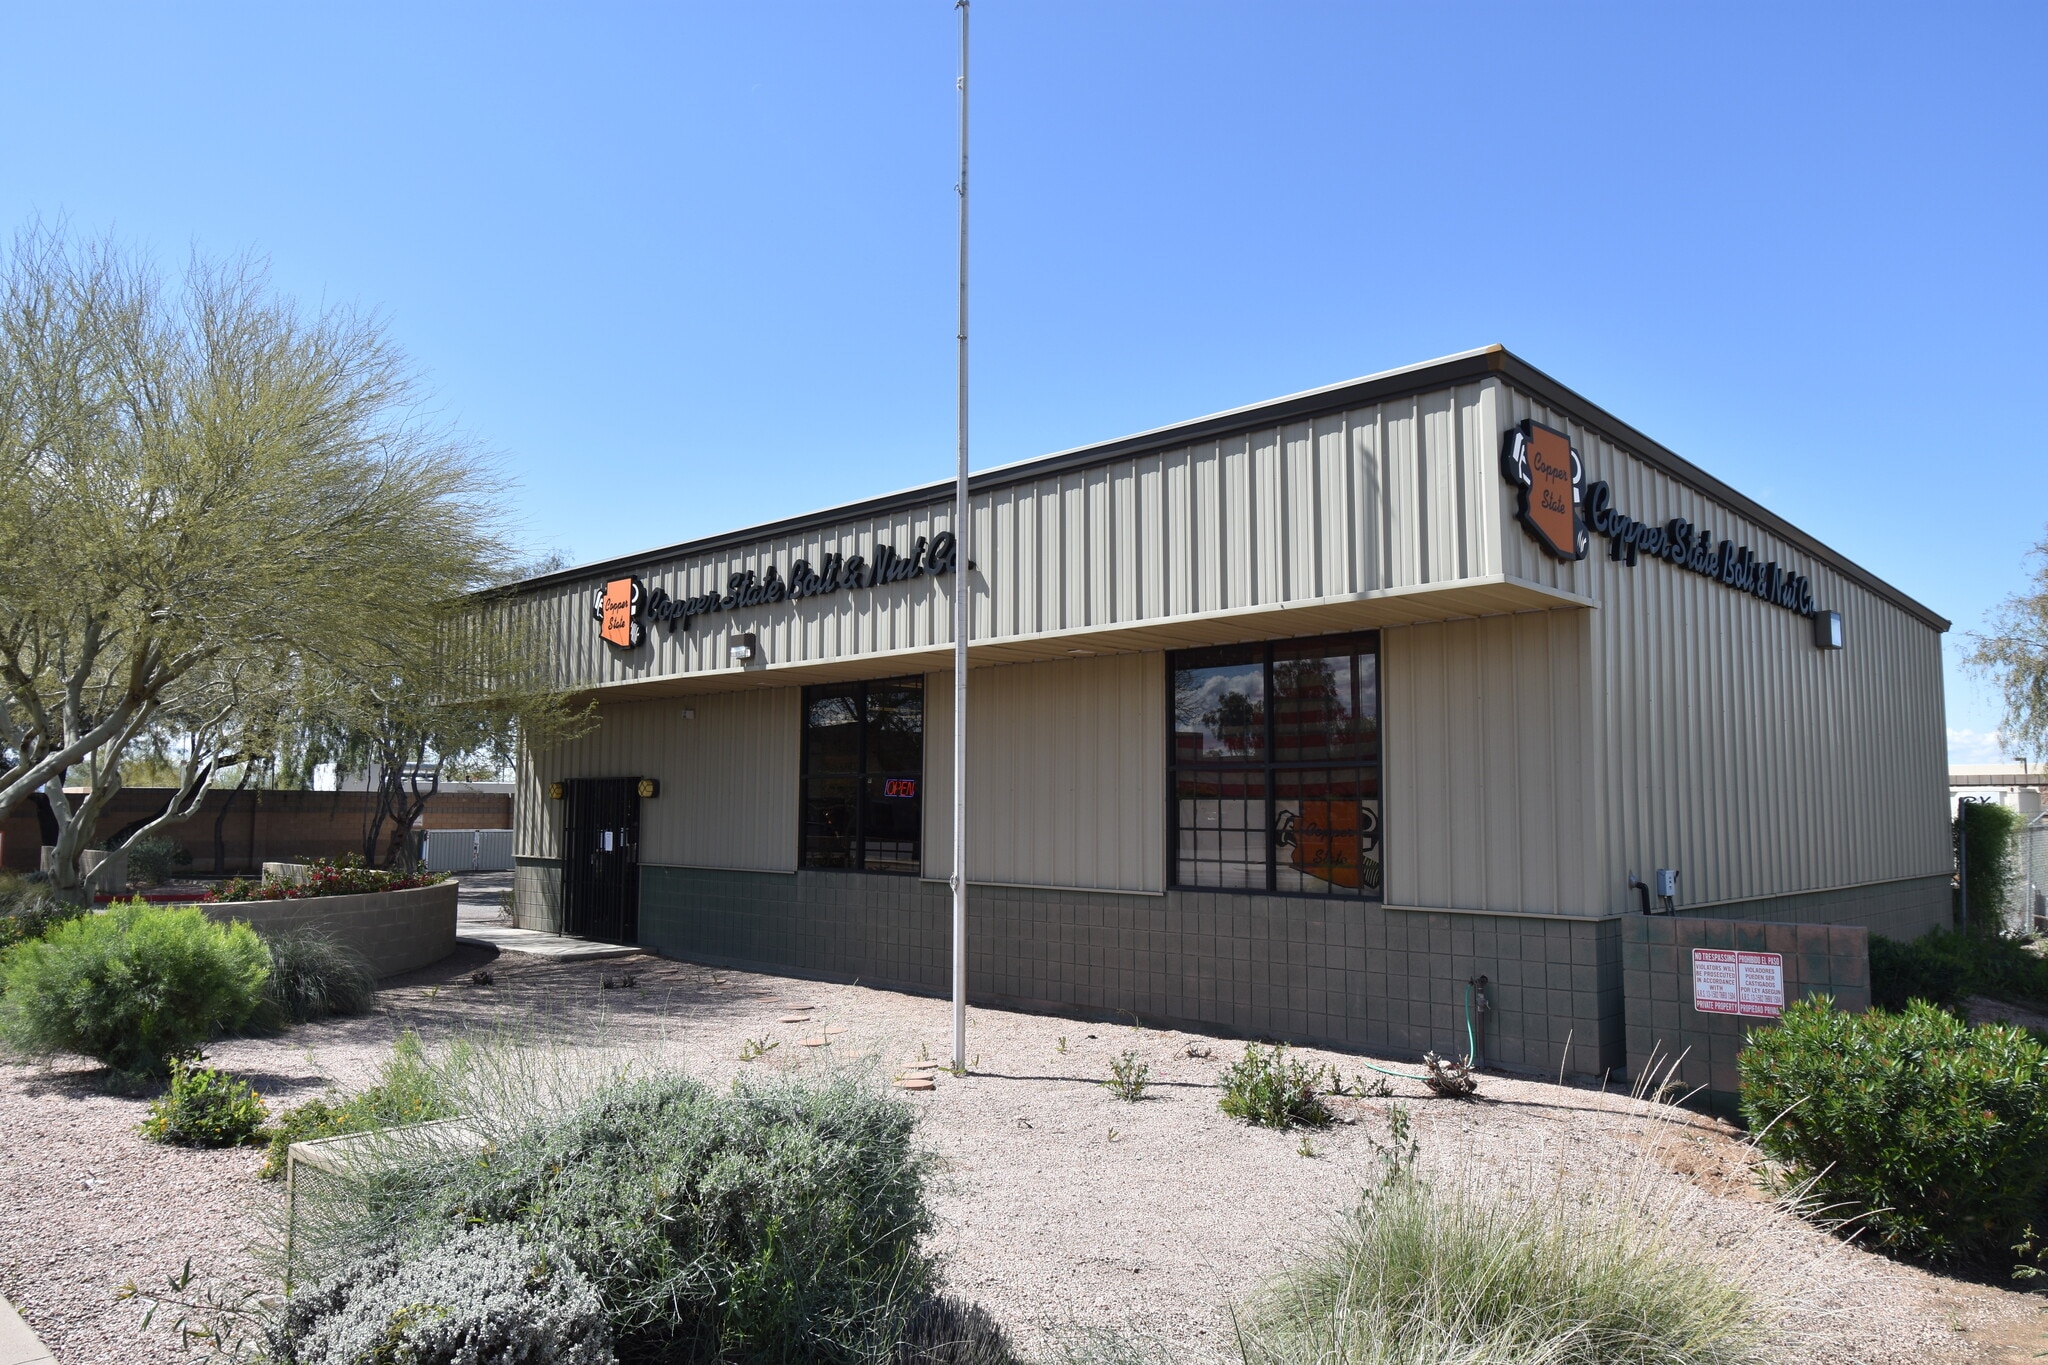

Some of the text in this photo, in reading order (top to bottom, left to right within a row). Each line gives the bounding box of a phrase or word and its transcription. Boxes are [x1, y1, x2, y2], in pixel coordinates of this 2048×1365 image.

[1533, 452, 1568, 482] Copper
[1541, 489, 1566, 514] State
[1586, 480, 1669, 567] Copper
[1668, 517, 1719, 577] State
[1722, 540, 1755, 592] Bolt
[1757, 563, 1768, 599] &
[1769, 562, 1798, 611] Nut
[647, 587, 721, 633] Copper
[720, 567, 782, 609] State
[785, 553, 842, 600] Bolt
[840, 555, 864, 590] &
[863, 536, 927, 588] Nut
[604, 598, 629, 615] Copper
[608, 615, 626, 630] State
[886, 780, 914, 797] OPEN
[1694, 952, 1736, 962] NO TRESPASSING
[1761, 956, 1767, 964] EL
[1768, 957, 1780, 965] PASO
[1696, 1000, 1737, 1011] PRIVATE PROPERTY
